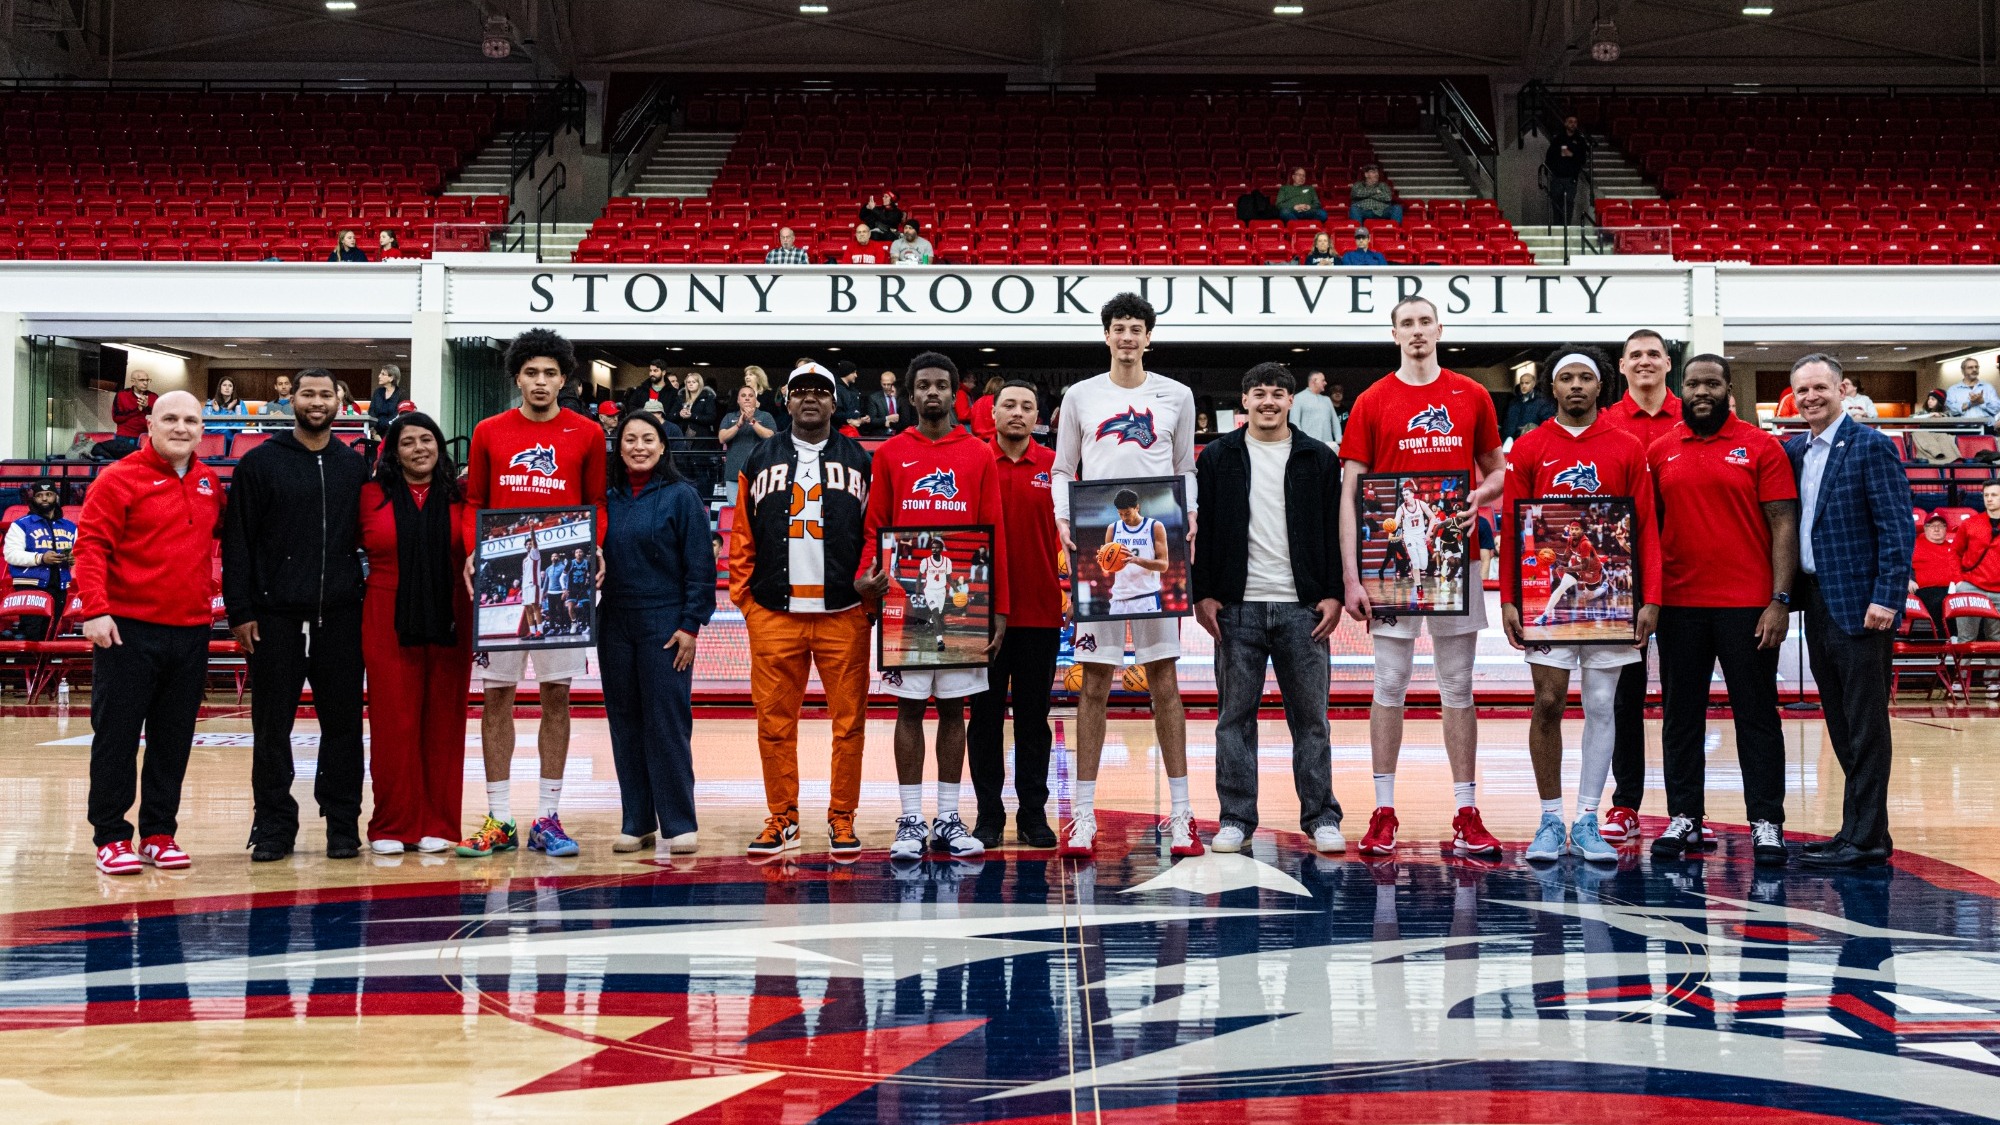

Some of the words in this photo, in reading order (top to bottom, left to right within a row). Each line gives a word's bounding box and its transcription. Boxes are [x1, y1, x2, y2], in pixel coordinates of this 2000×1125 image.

[530, 273, 783, 313] STONY
[827, 274, 1094, 314] BROOK
[1399, 437, 1428, 450] STONY
[1432, 436, 1463, 447] BROOK
[1413, 446, 1452, 454] BASKETBALL
[500, 475, 529, 486] STONY
[532, 475, 566, 490] BROOK
[511, 486, 551, 494] BASKETBALL
[788, 481, 824, 539] 23
[902, 499, 931, 510] STONY
[934, 500, 967, 511] BROOK
[1411, 518, 1419, 527] 17
[3, 595, 26, 608] STONY
[26, 594, 47, 609] BROOK
[1949, 596, 1968, 609] STONY
[1968, 596, 1991, 609] BROOK
